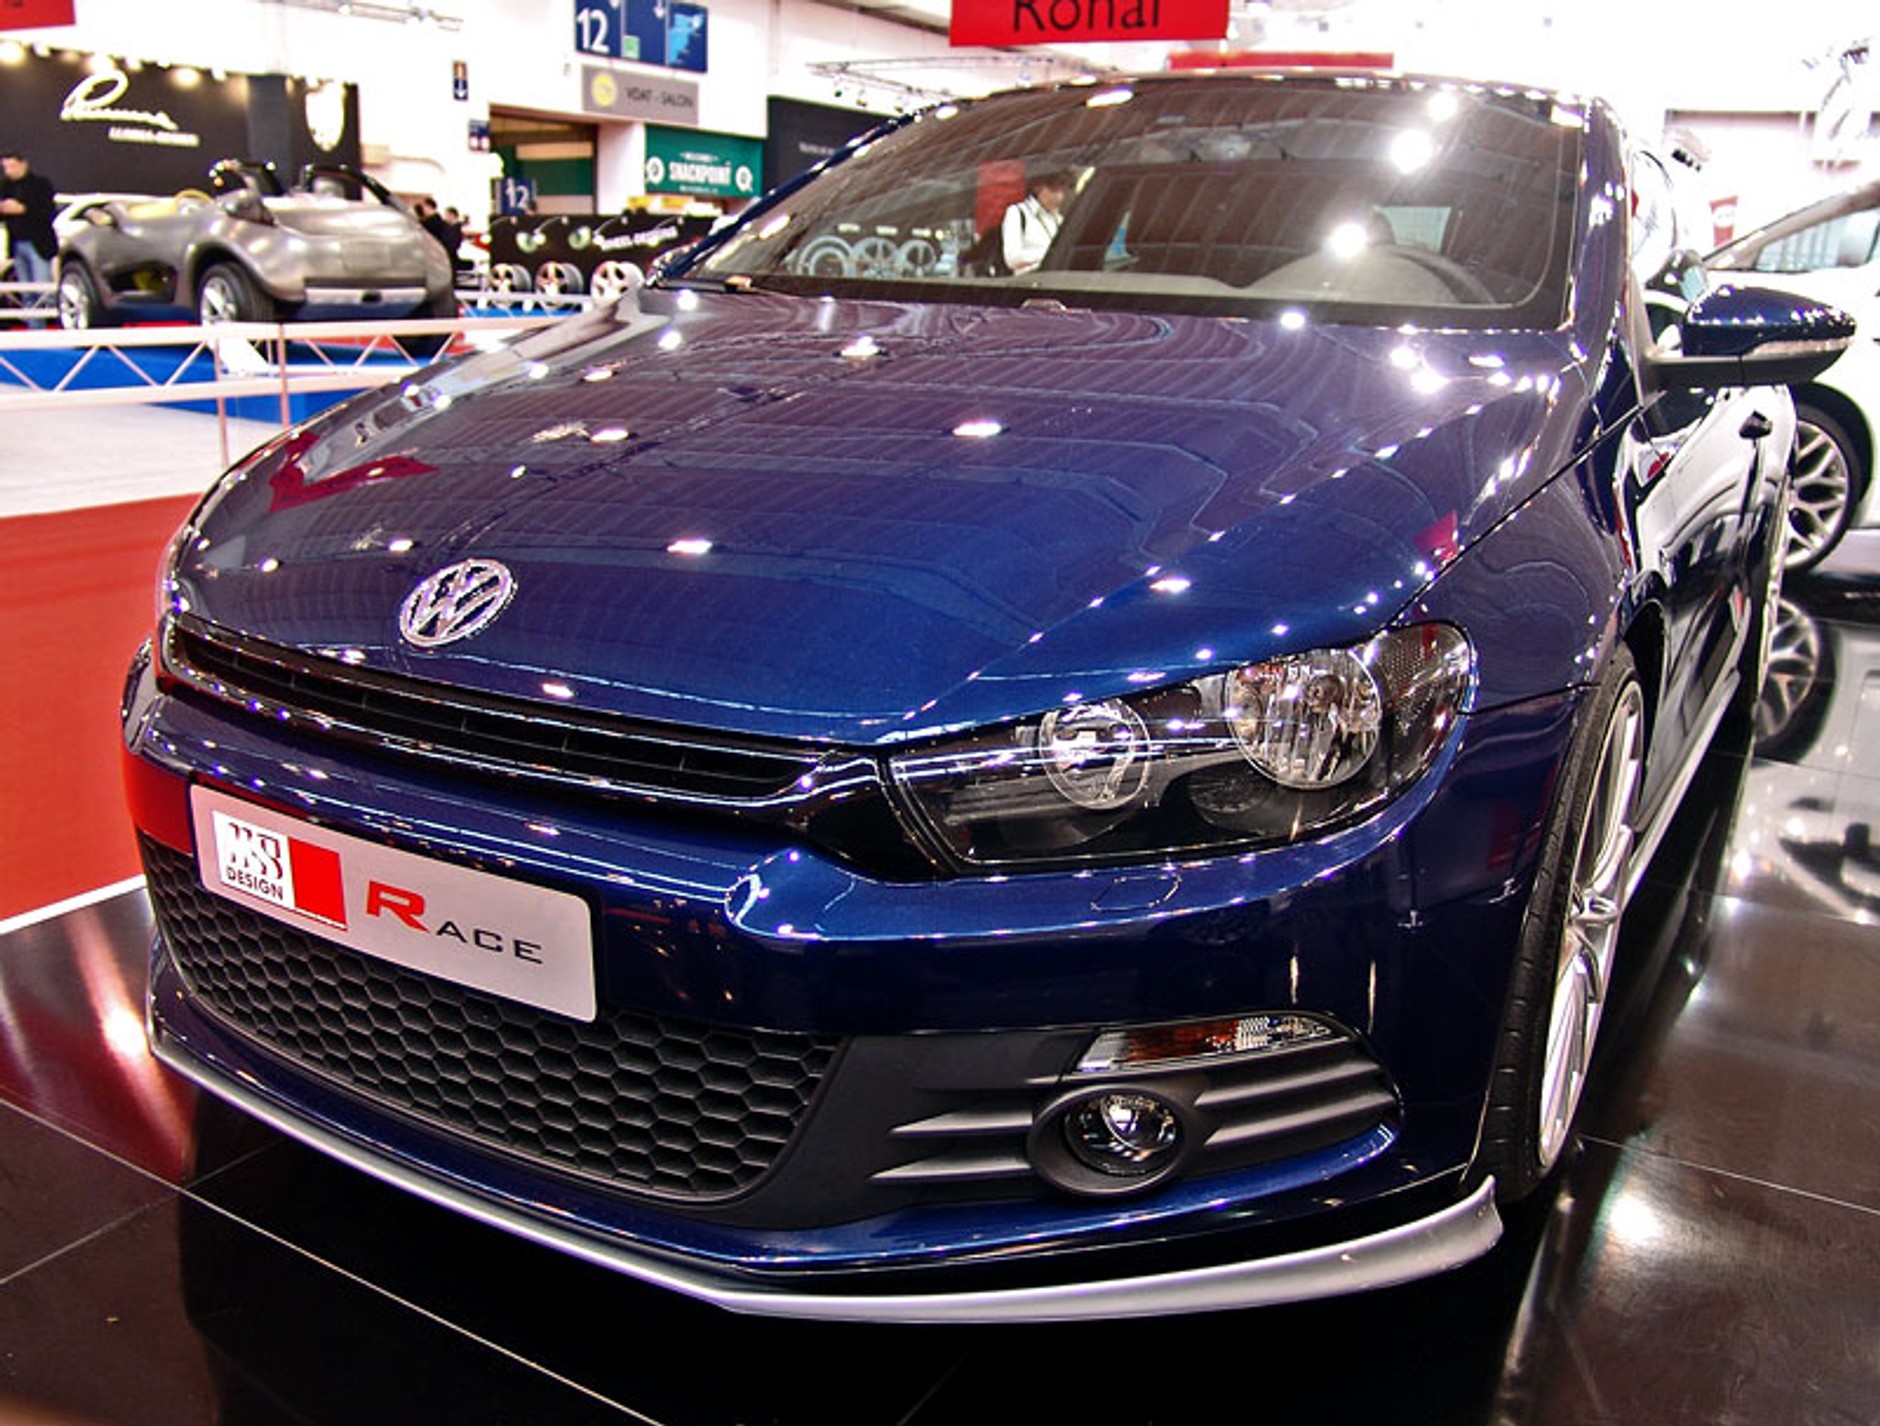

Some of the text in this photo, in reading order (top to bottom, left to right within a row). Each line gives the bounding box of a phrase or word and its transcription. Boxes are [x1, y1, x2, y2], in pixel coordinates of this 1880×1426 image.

[576, 7, 610, 53] 12
[505, 180, 530, 209] 12
[226, 865, 284, 901] DESIGN
